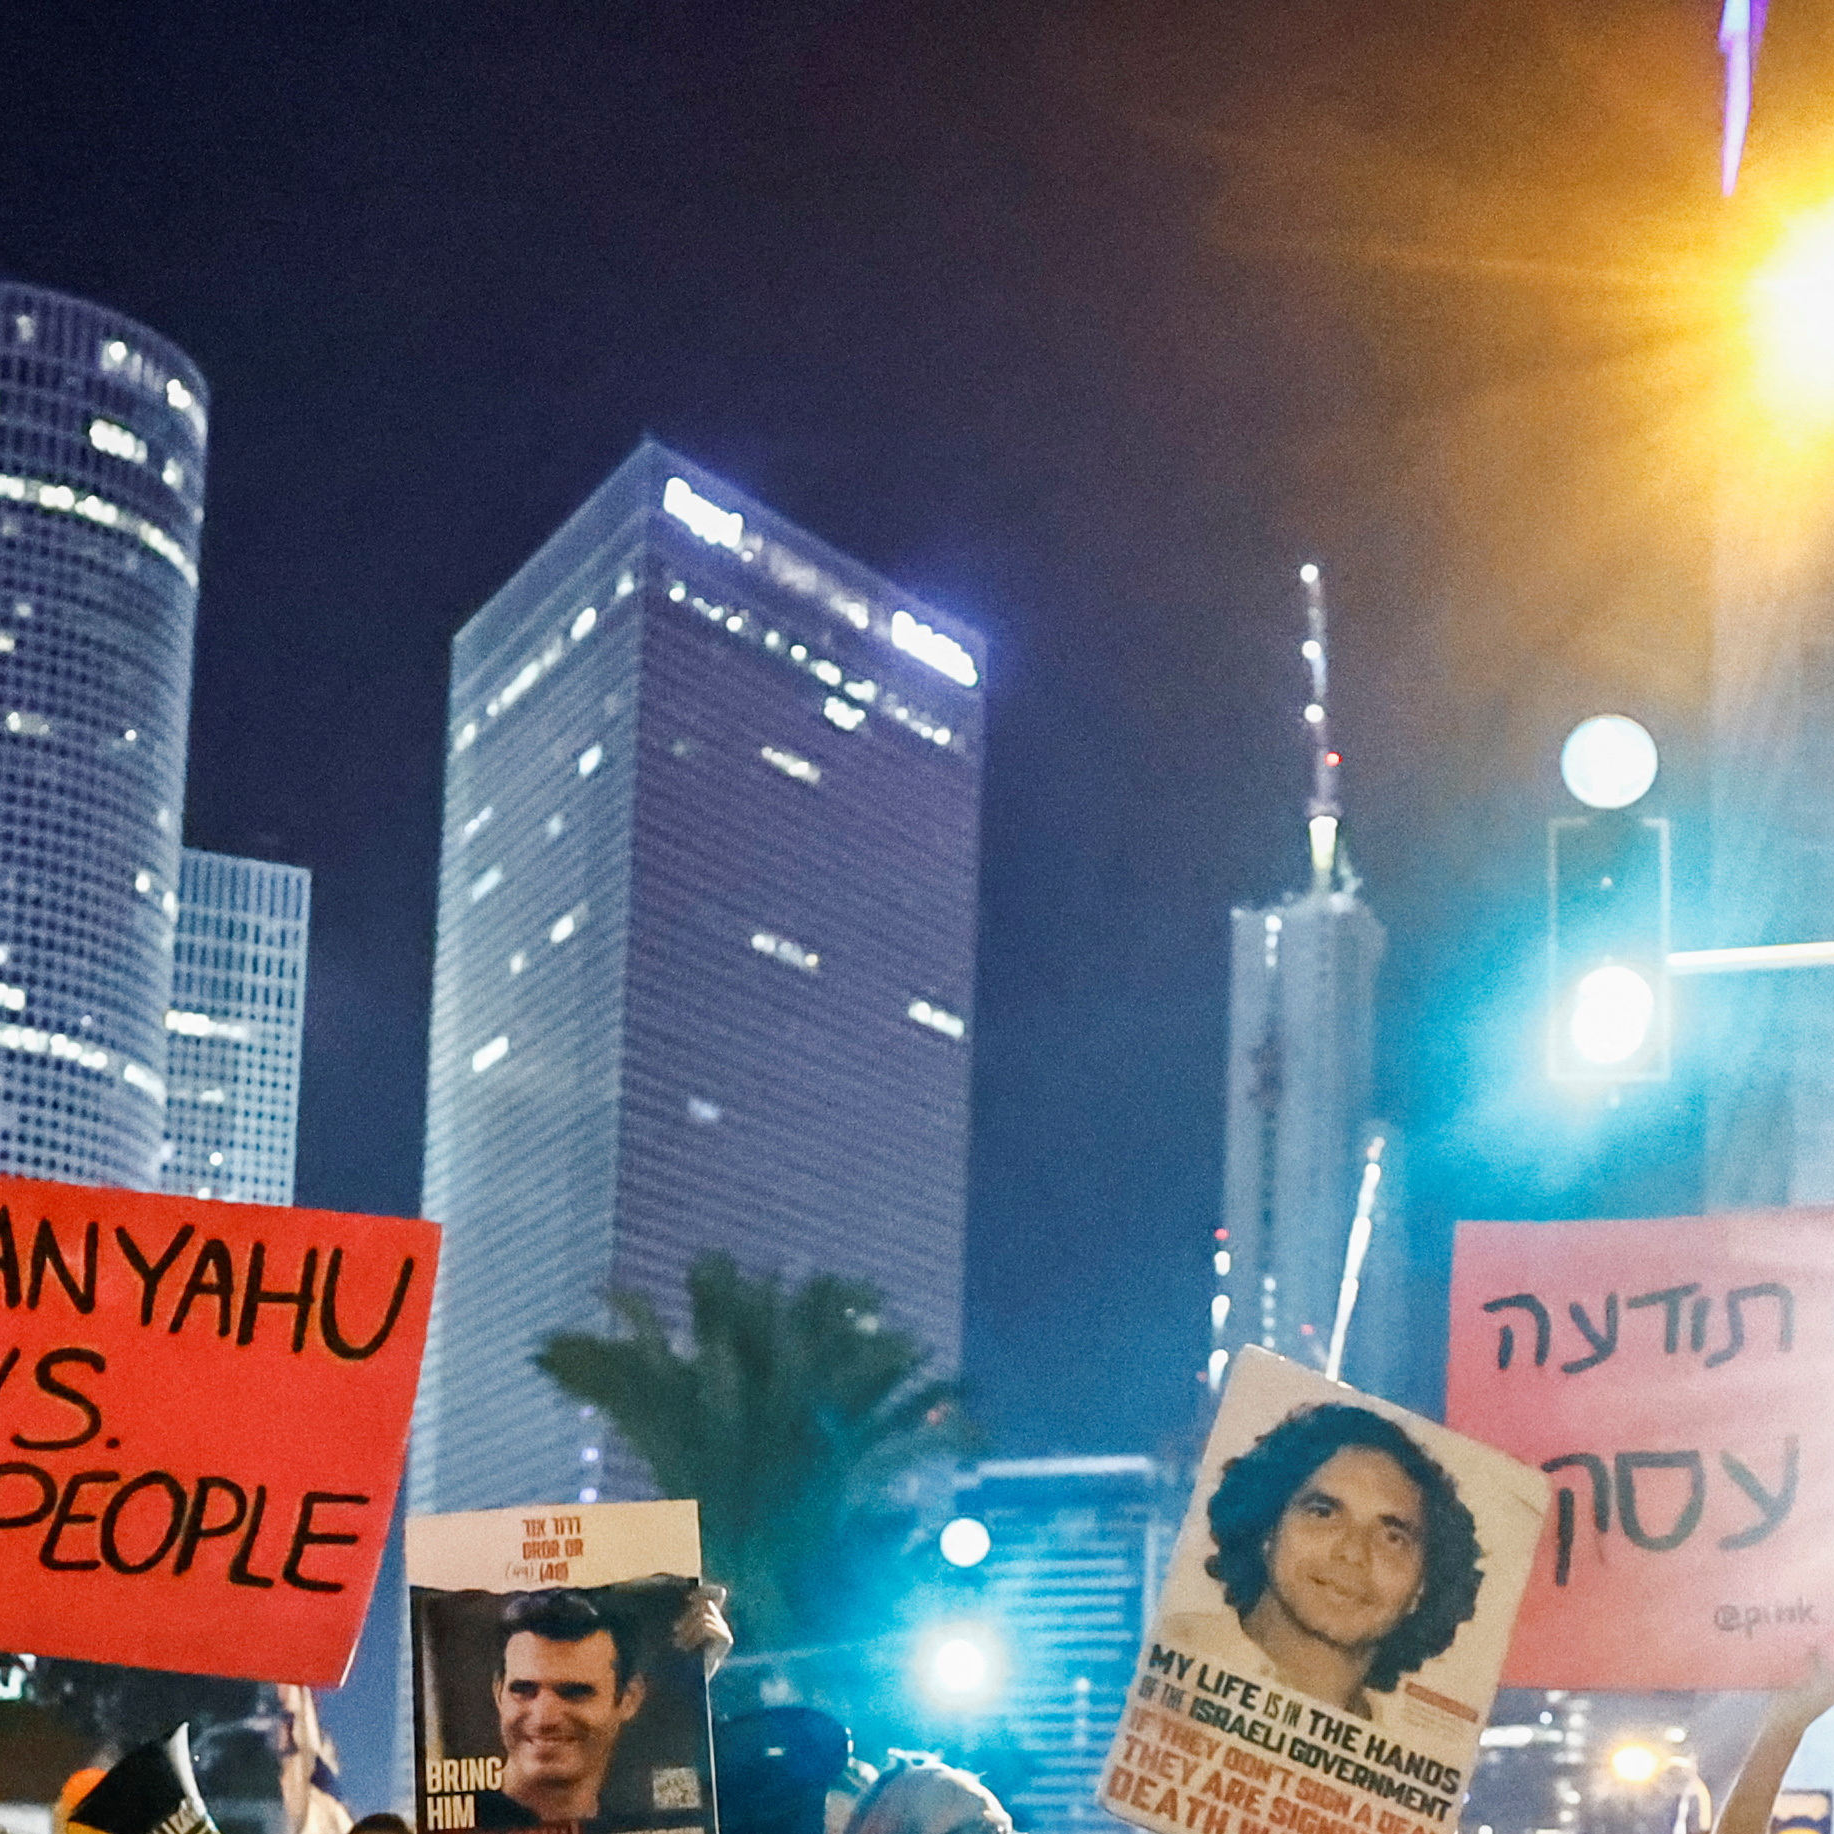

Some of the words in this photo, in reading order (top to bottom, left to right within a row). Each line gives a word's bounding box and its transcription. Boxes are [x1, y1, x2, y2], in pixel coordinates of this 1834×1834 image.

[1481, 1281, 1798, 1374] תודעה
[1137, 1674, 1158, 1700] OF
[1161, 1681, 1185, 1712] THE
[1189, 1695, 1287, 1754] ISRAELI
[1287, 1734, 1454, 1822] GOVERNMENT
[1147, 1643, 1197, 1682] MY
[1196, 1662, 1262, 1711] LIFE
[1262, 1690, 1283, 1720] IS
[1308, 1708, 1358, 1754] THE
[1364, 1733, 1462, 1796] HANDS
[425, 1756, 504, 1795] BRING
[426, 1793, 477, 1832] HIM
[1122, 1733, 1208, 1787] THEY
[1201, 1768, 1265, 1817] ARE
[1129, 1705, 1156, 1734] IF
[1156, 1713, 1226, 1761] THEY
[1294, 1774, 1357, 1816] SIGN
[1353, 1801, 1373, 1828] A
